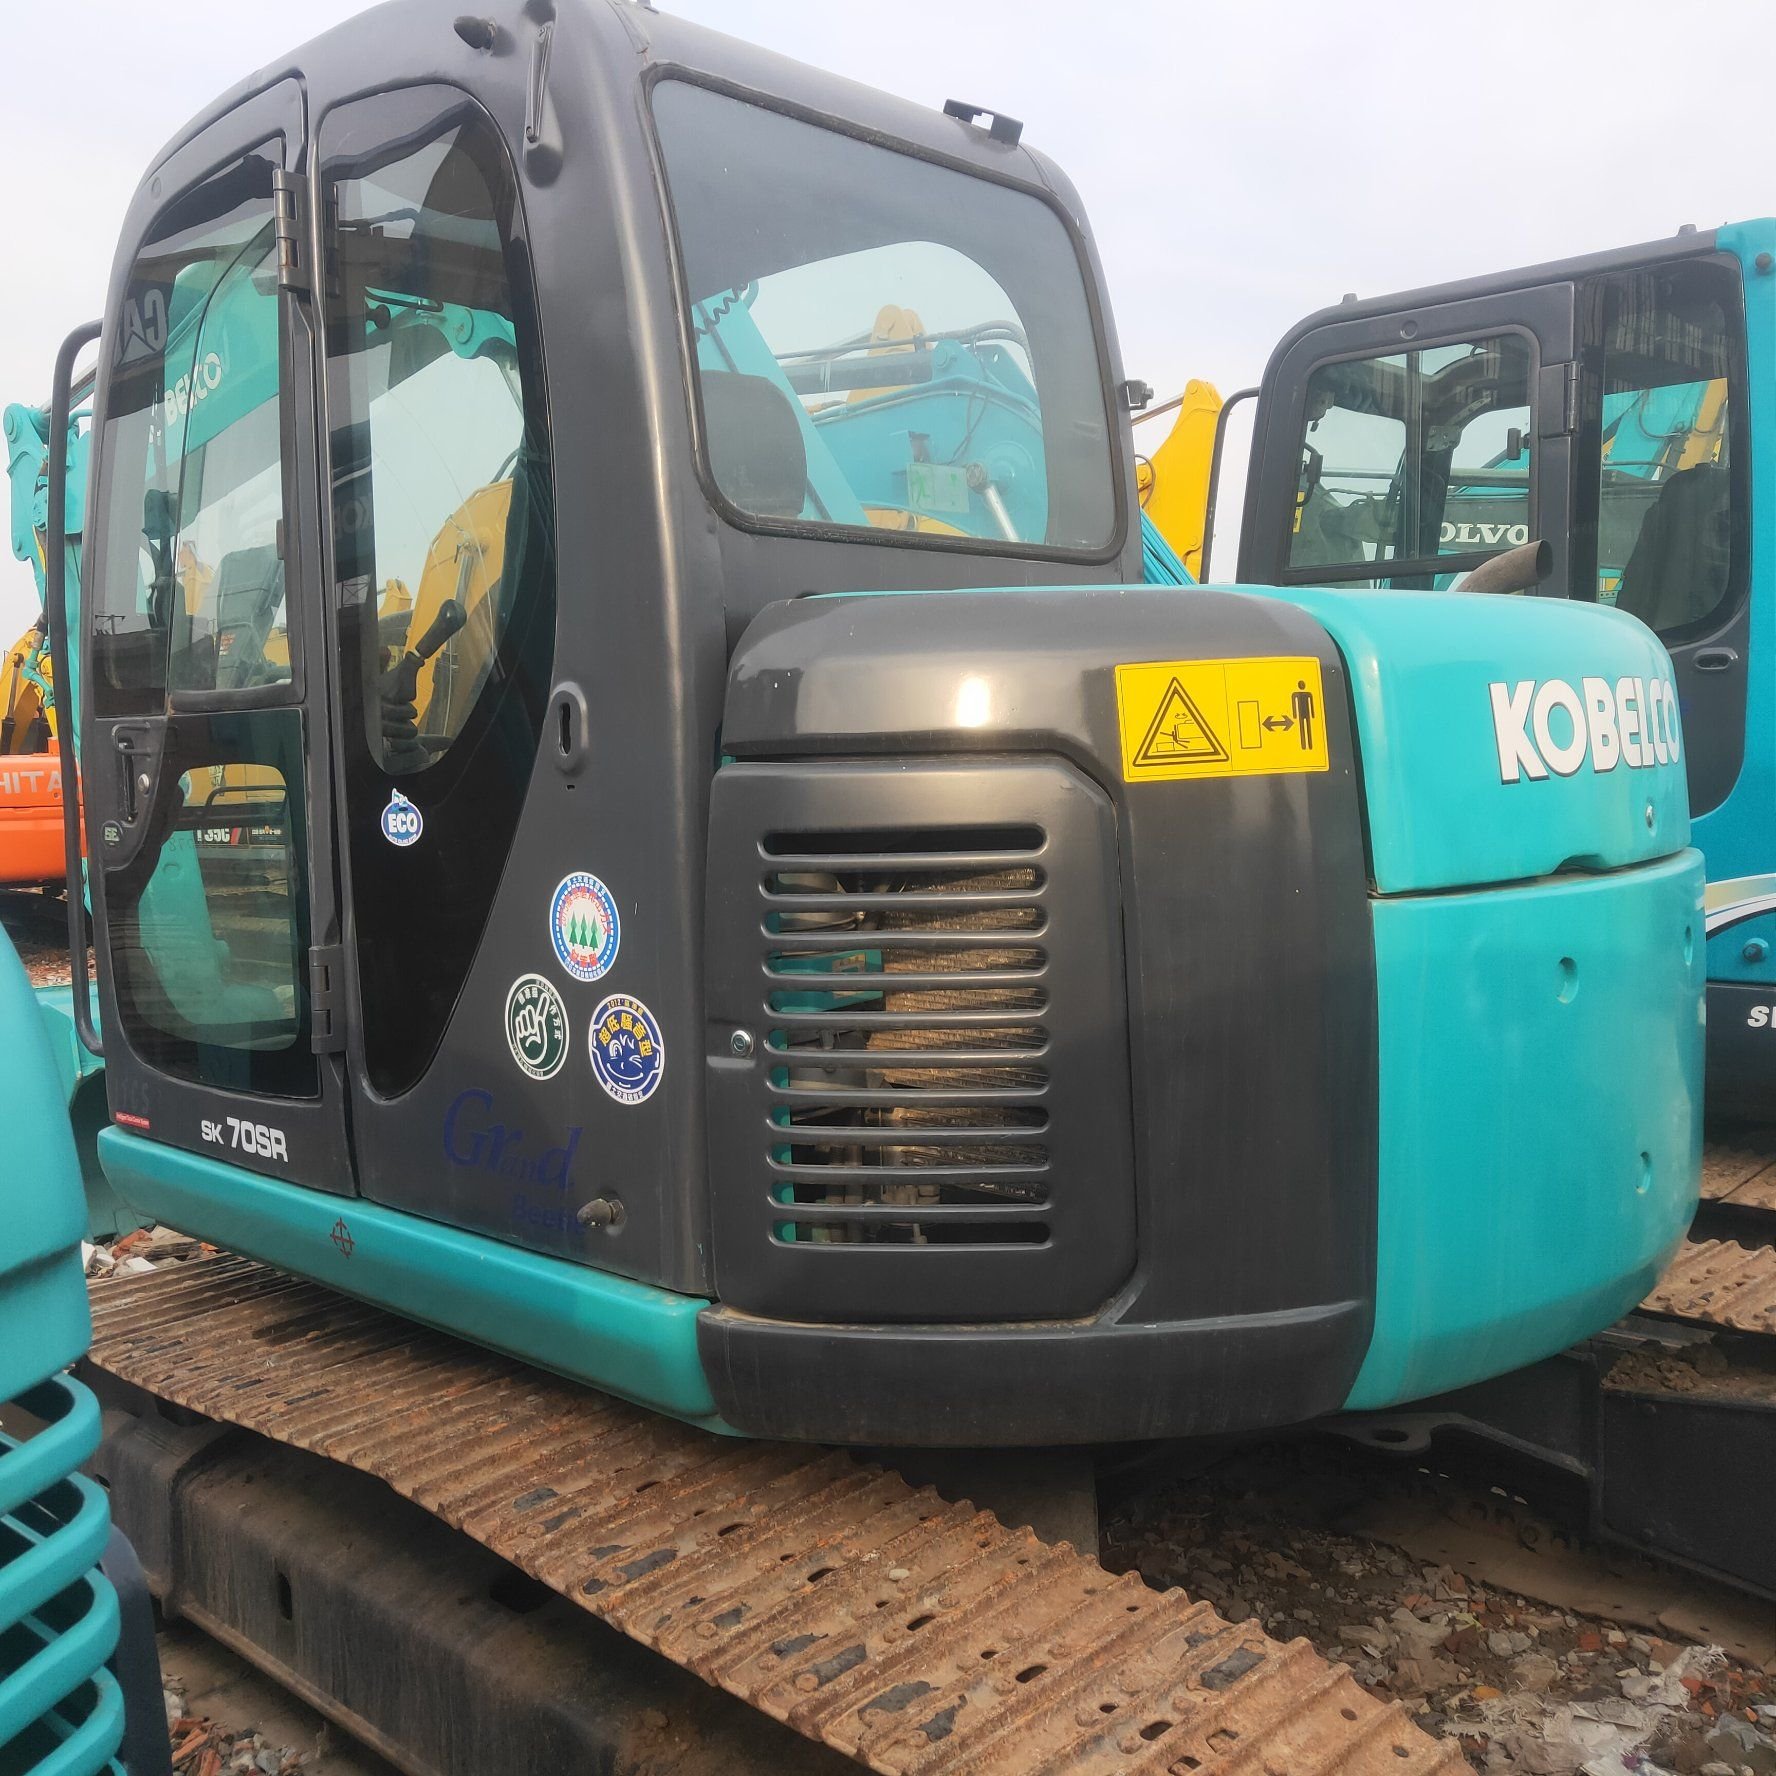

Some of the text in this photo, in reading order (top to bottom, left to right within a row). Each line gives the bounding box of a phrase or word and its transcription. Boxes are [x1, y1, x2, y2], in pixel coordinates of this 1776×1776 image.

[1488, 676, 1680, 784] KOBELCO
[387, 812, 418, 833] ECO
[1747, 1005, 1776, 1028] S
[201, 1116, 289, 1163] SK 70SR
